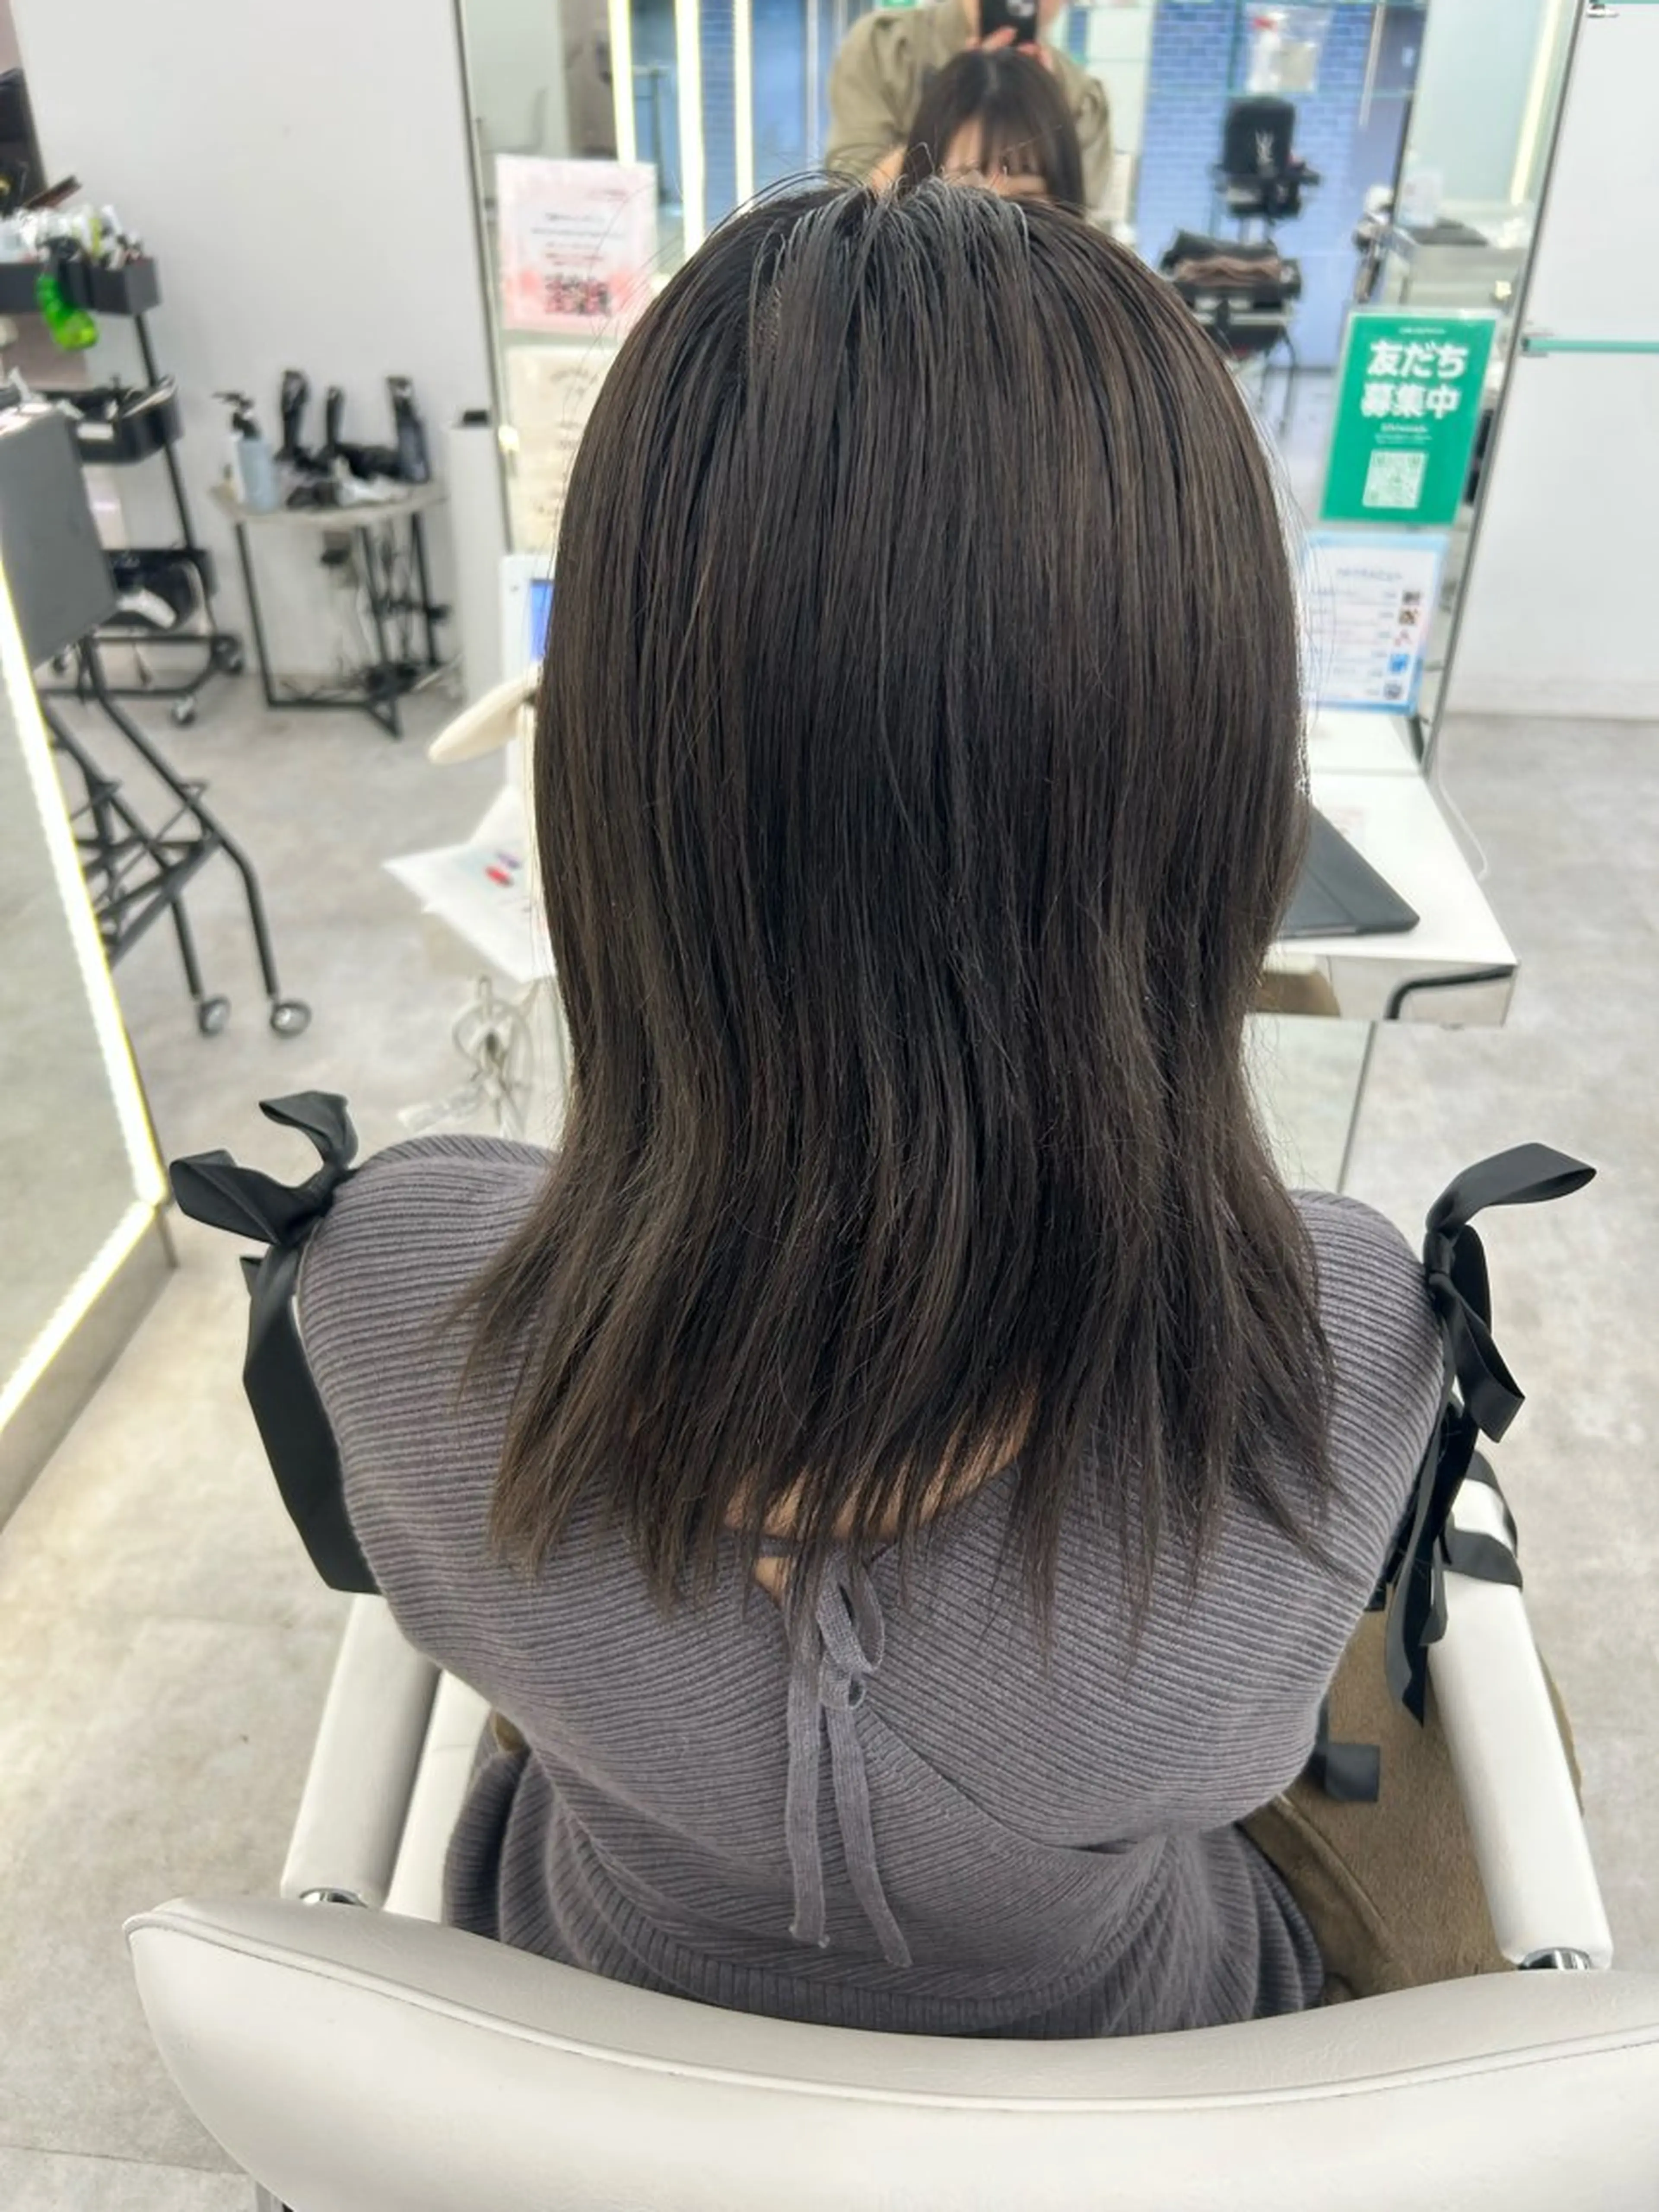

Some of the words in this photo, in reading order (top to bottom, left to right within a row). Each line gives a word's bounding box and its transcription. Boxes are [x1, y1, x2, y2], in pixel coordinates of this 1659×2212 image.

[1367, 339, 1468, 378] 友だち
[1360, 383, 1461, 419] 募集中
